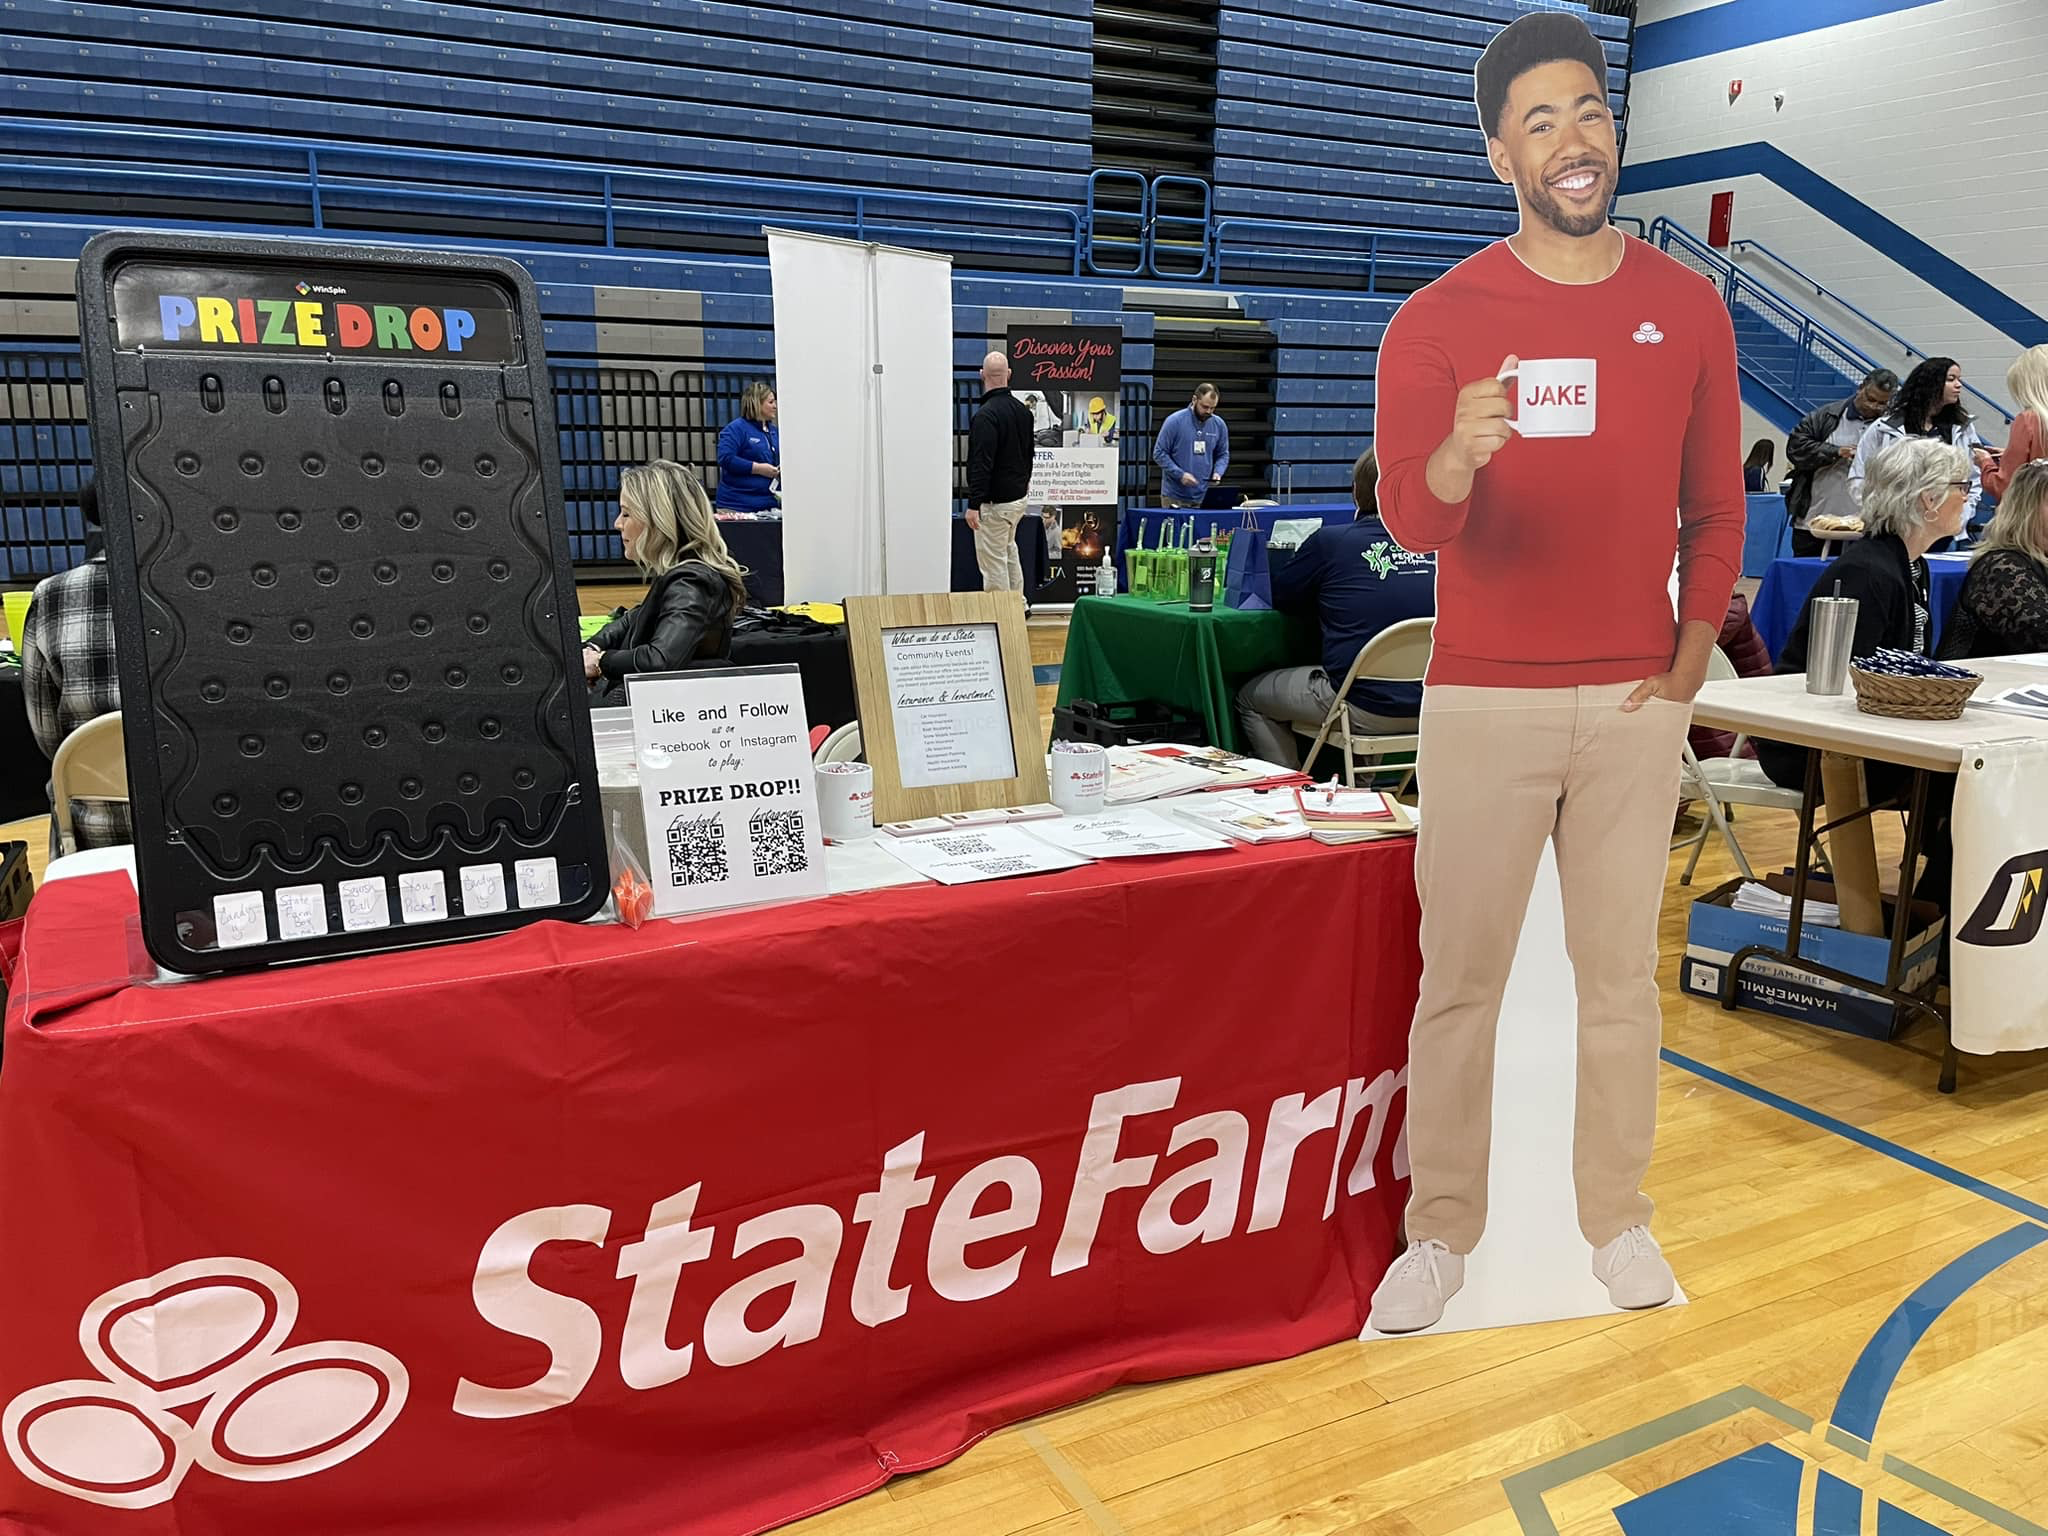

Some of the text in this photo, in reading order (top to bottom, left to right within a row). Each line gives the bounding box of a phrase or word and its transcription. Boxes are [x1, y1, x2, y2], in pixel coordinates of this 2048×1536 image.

[312, 284, 347, 295] WinSpin
[159, 296, 475, 352] PRIZE DROP
[1013, 338, 1114, 367] Discover Your
[1031, 358, 1095, 382] Passion!
[1526, 385, 1587, 406] JAKE
[1034, 451, 1055, 460] FFER:
[1027, 489, 1044, 497] pire
[891, 632, 915, 645] What
[930, 632, 939, 642] do
[941, 632, 952, 641] at
[953, 629, 976, 640] State
[896, 648, 974, 661] Community Events!
[897, 693, 934, 705] Insurance
[938, 690, 949, 702] &
[652, 702, 789, 723] Like and Follow
[651, 733, 798, 753] Facebook or Instagram
[708, 753, 744, 771] to play:
[659, 778, 801, 807] PRIZE DROP!!
[280, 894, 309, 908] State
[1760, 923, 1824, 941] HAMMMILL
[1738, 979, 1837, 1011] HAMMERMIL
